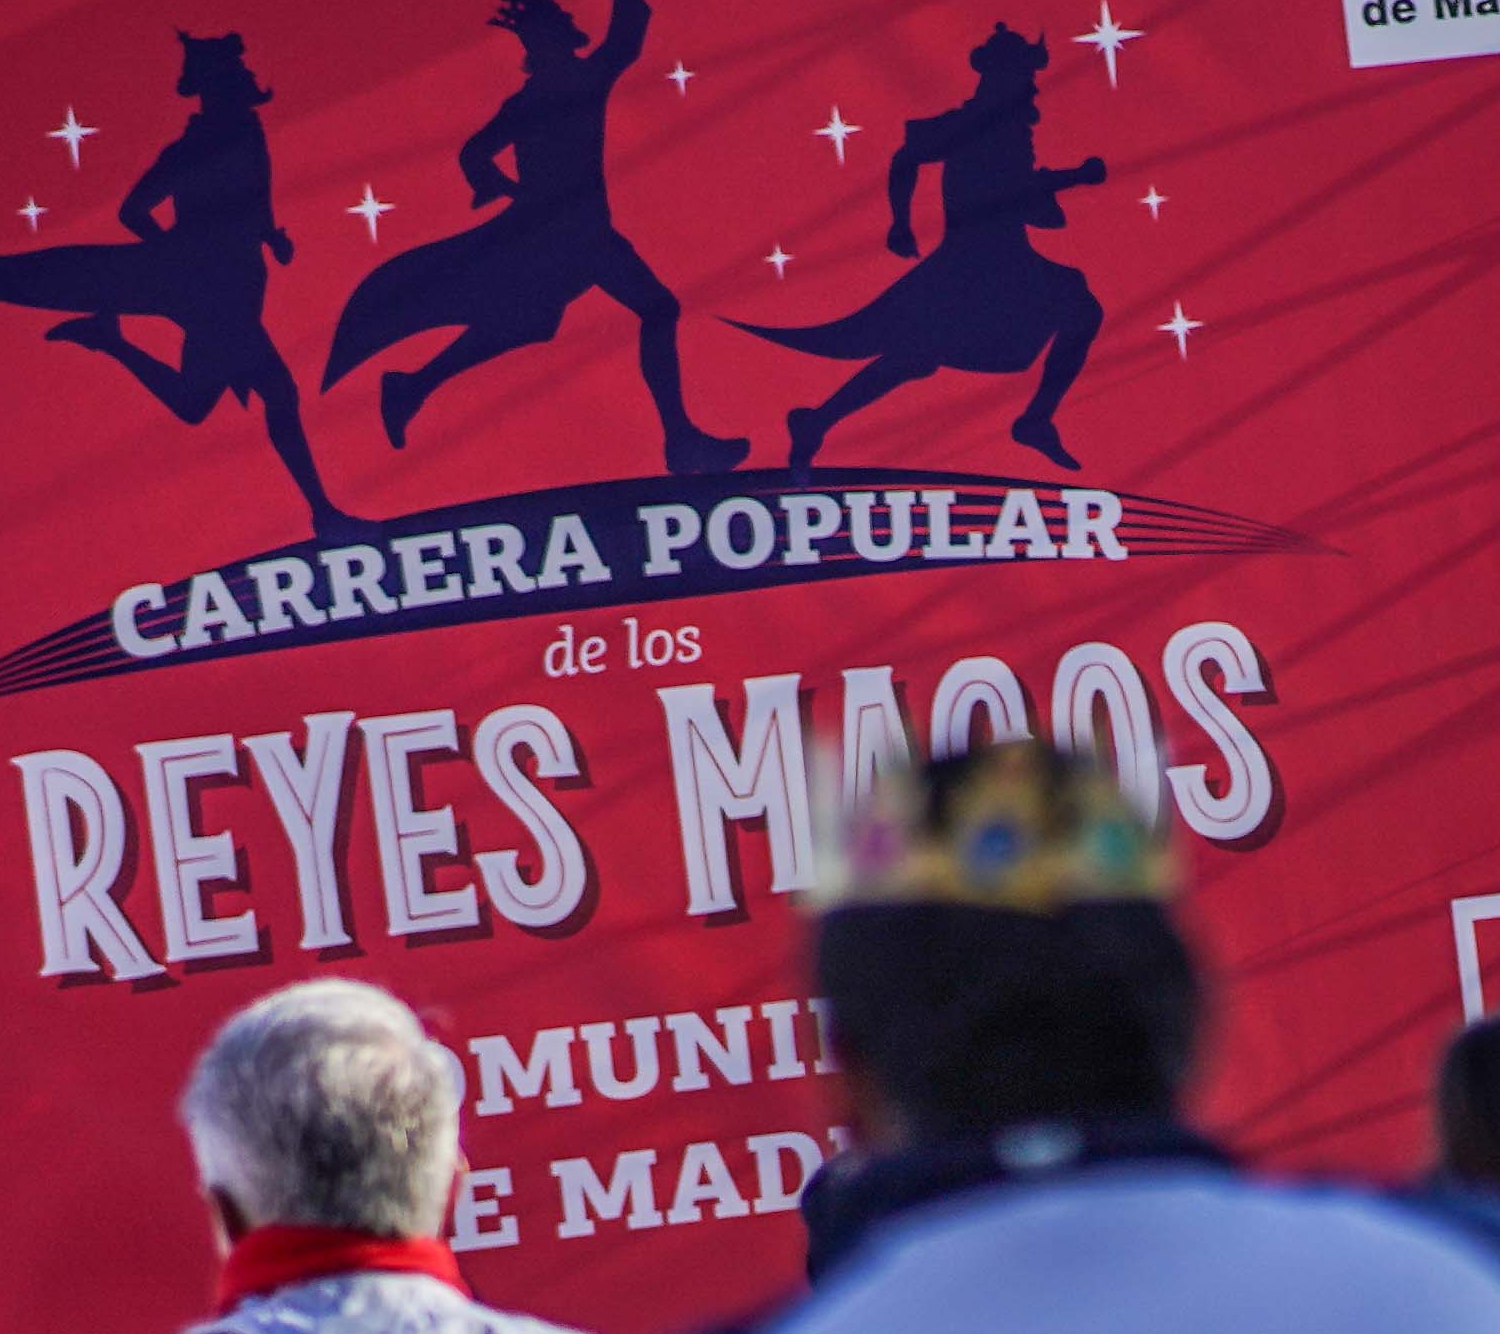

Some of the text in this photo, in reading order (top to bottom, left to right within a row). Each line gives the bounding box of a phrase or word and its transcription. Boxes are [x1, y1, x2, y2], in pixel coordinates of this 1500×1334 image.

[111, 488, 1129, 658] CARRERA POPULAR
[543, 617, 702, 678] de los
[10, 704, 590, 982] REYES
